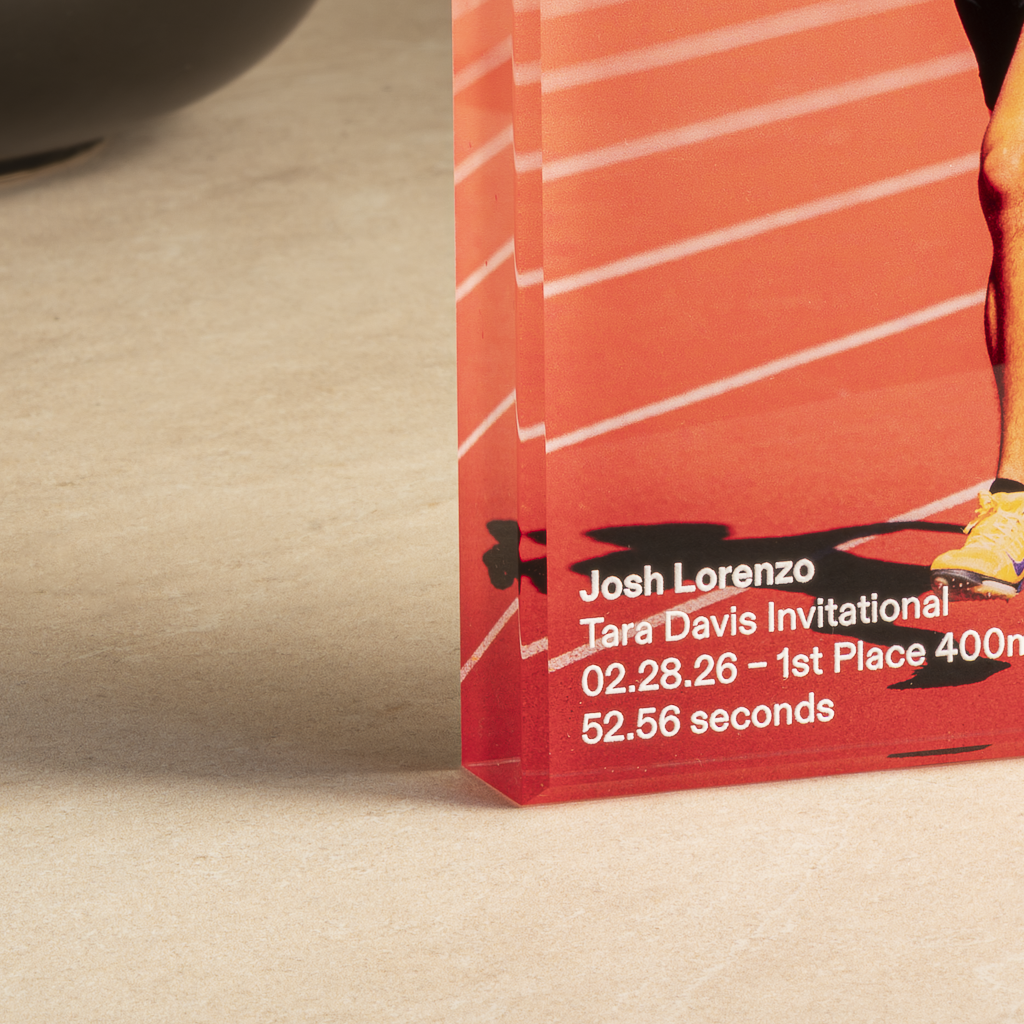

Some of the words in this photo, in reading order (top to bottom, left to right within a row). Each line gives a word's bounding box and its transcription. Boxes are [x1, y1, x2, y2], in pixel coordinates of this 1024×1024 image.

[579, 564, 664, 603] Josh
[674, 558, 816, 594] Lorenzo
[580, 616, 654, 650] Tara
[665, 605, 758, 642] Davis
[768, 585, 949, 633] Invitational
[581, 652, 738, 697] 02.28.26
[776, 646, 824, 679] 1st
[833, 639, 927, 674] Place
[581, 704, 681, 745] 52.56
[690, 691, 835, 735] seconds
